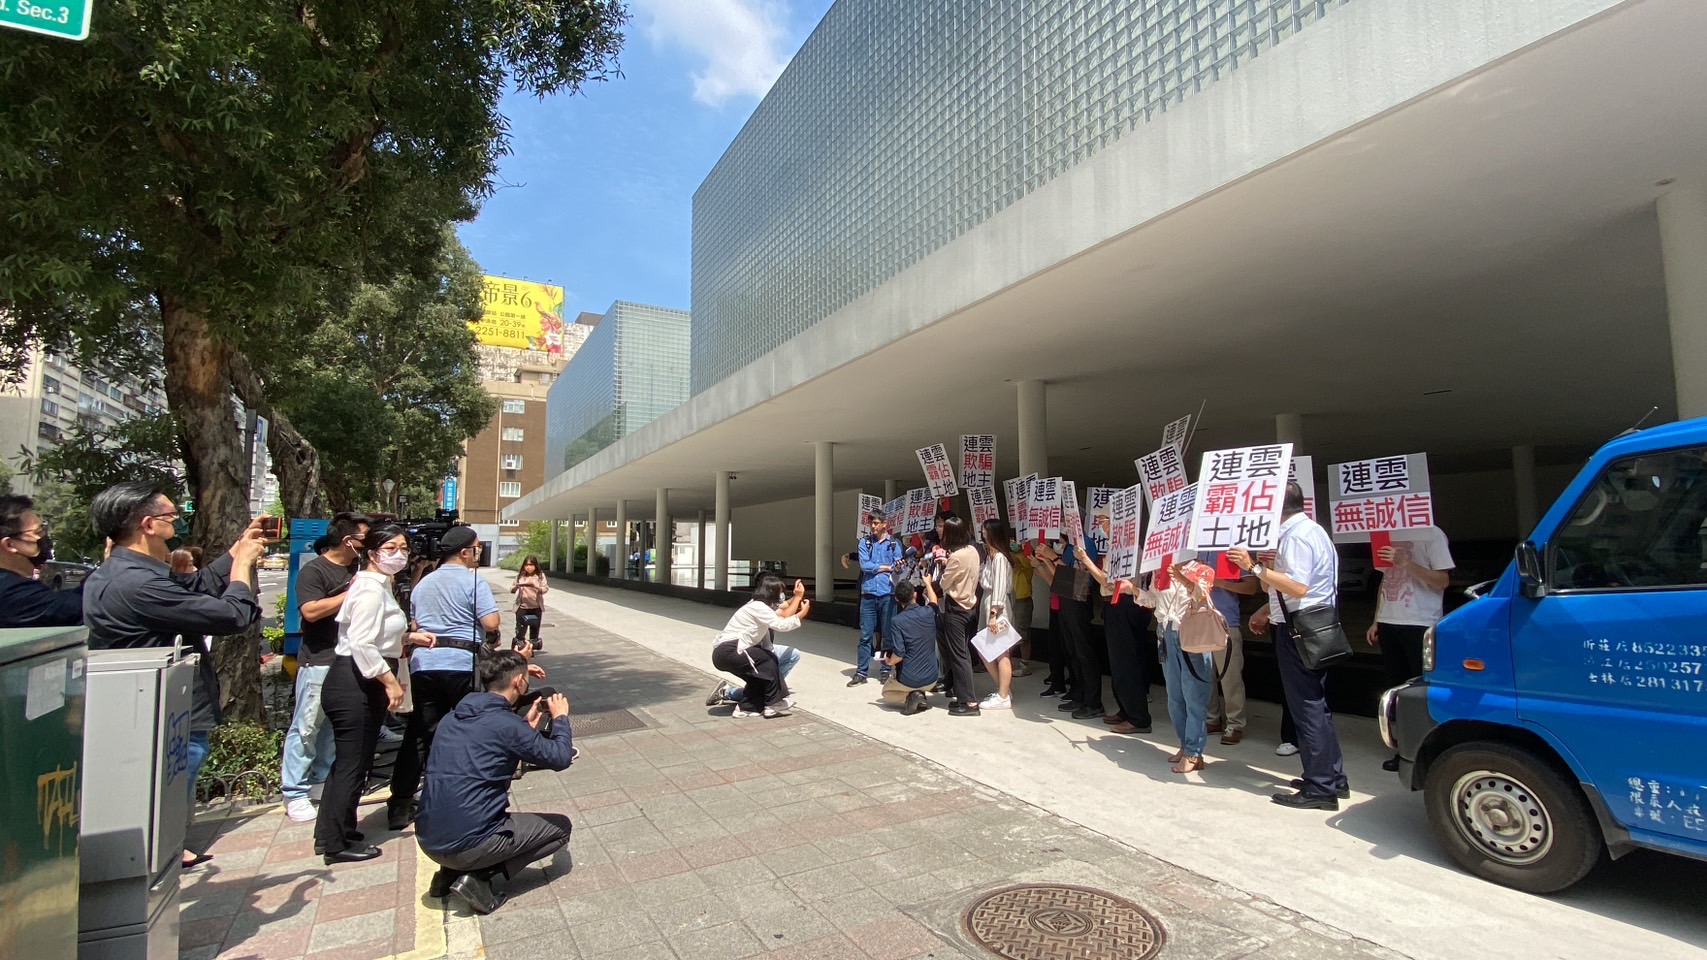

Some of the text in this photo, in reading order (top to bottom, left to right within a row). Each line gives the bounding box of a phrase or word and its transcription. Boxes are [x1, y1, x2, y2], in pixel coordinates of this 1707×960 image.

[17, 0, 69, 24] Sec.3
[920, 444, 946, 465] 連雲
[963, 435, 993, 453] 連雲
[927, 462, 951, 481] 霸佔
[963, 453, 993, 470] 欺騙
[1142, 446, 1180, 483] 連雲
[1209, 446, 1283, 482] 連雲
[962, 471, 992, 488] 地主
[1342, 457, 1409, 494] 連雲
[910, 490, 934, 504] 連雲
[933, 480, 956, 498] 土地
[971, 487, 993, 506] 連雲
[1034, 478, 1056, 502] 連雲
[1093, 489, 1113, 508] 連
[1204, 480, 1278, 514] 霸佔
[908, 502, 934, 519] 欺騙
[1111, 487, 1137, 520] 連雲
[1158, 484, 1198, 525] 連雲
[1334, 494, 1431, 532] 無誠信
[905, 517, 931, 533] 地主
[1029, 505, 1060, 528] 無誠信
[1111, 518, 1136, 551] 欺騙
[1198, 516, 1271, 548] 土地
[1091, 533, 1109, 556] 地
[1109, 549, 1133, 580] 地主
